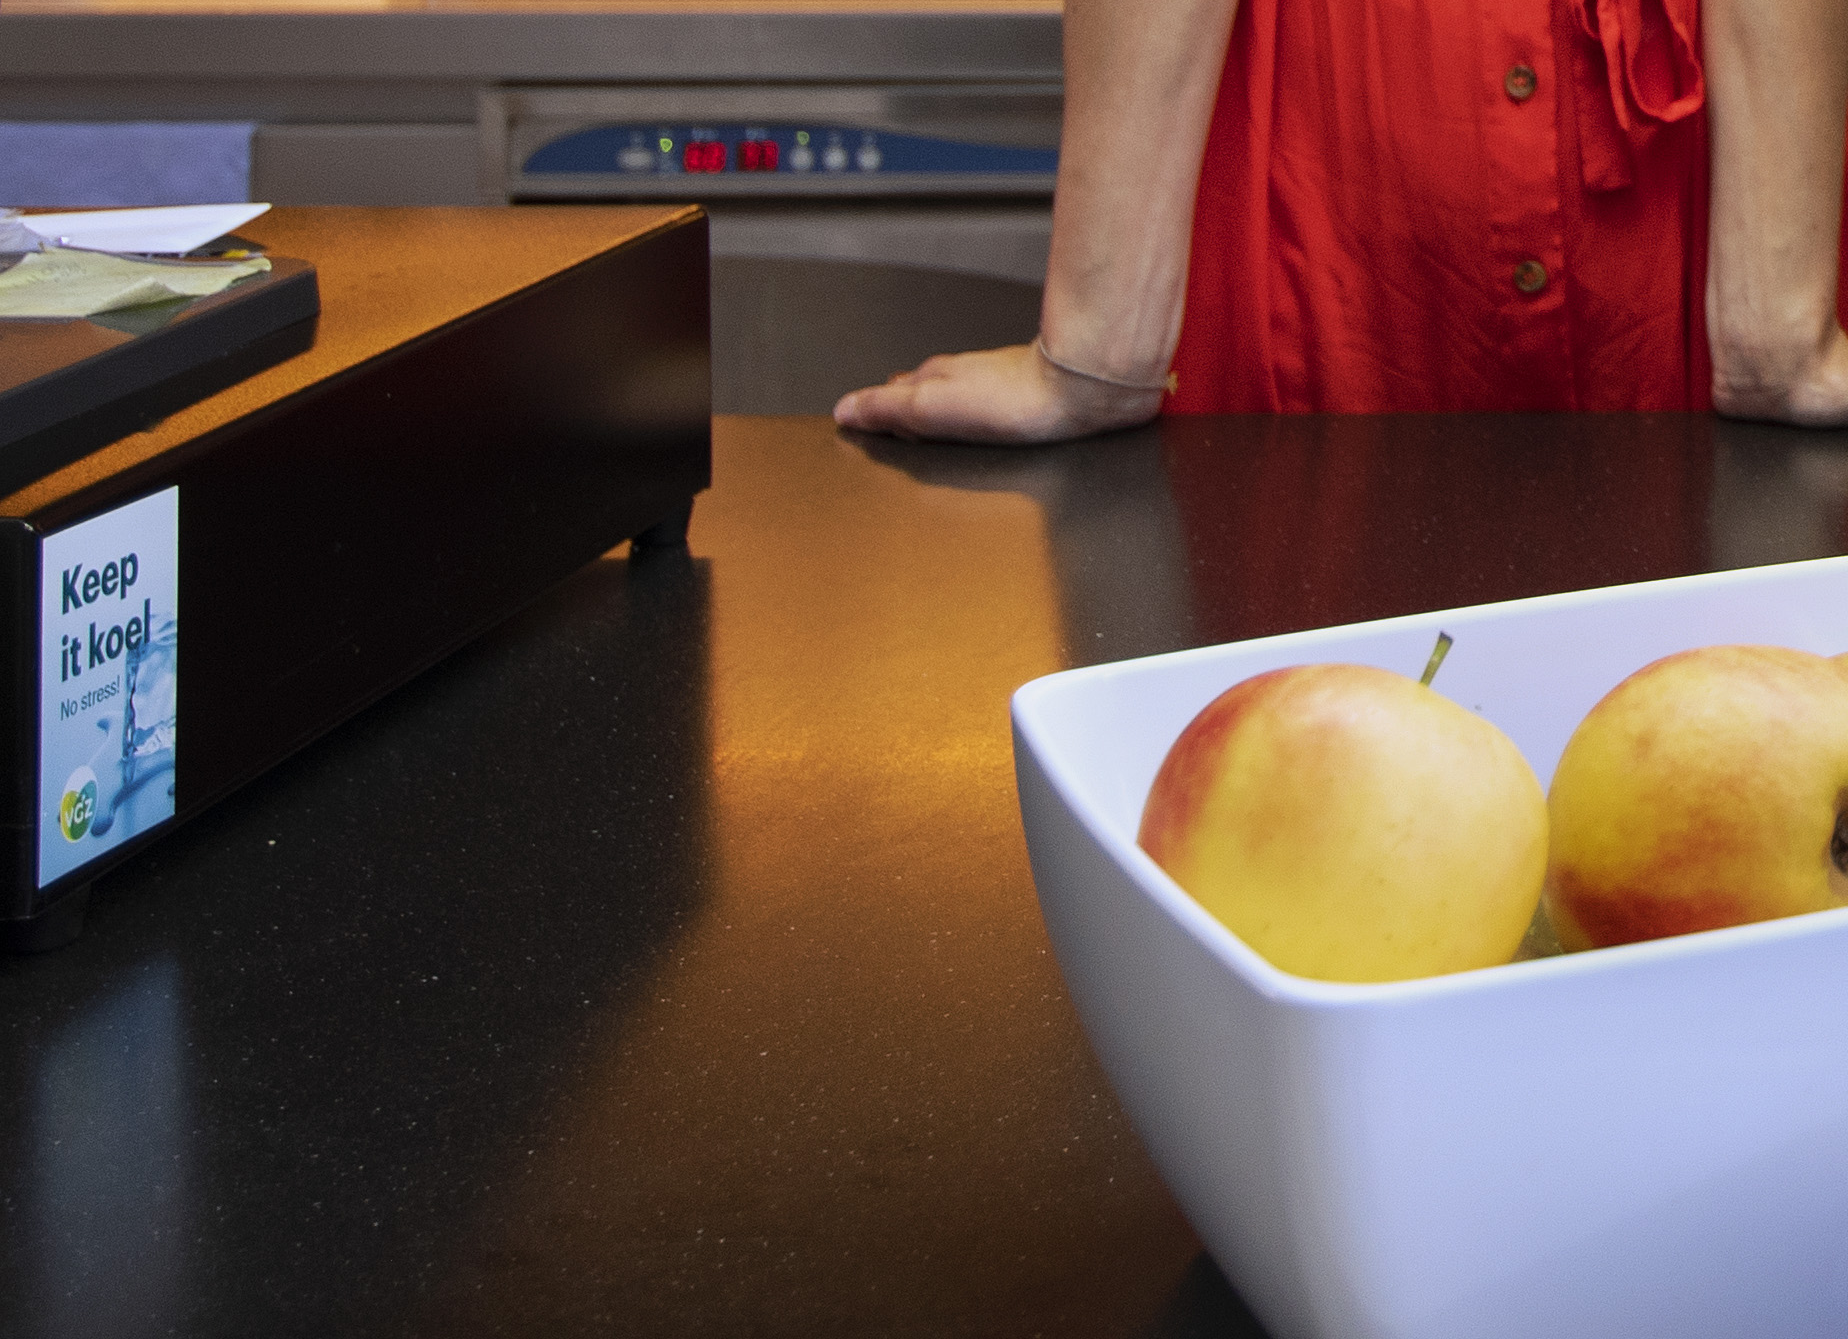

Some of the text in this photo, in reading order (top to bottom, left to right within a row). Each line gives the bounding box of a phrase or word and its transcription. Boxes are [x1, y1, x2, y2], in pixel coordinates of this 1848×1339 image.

[61, 551, 140, 615] Keep
[60, 598, 152, 683] it koel
[60, 674, 121, 722] No stress!
